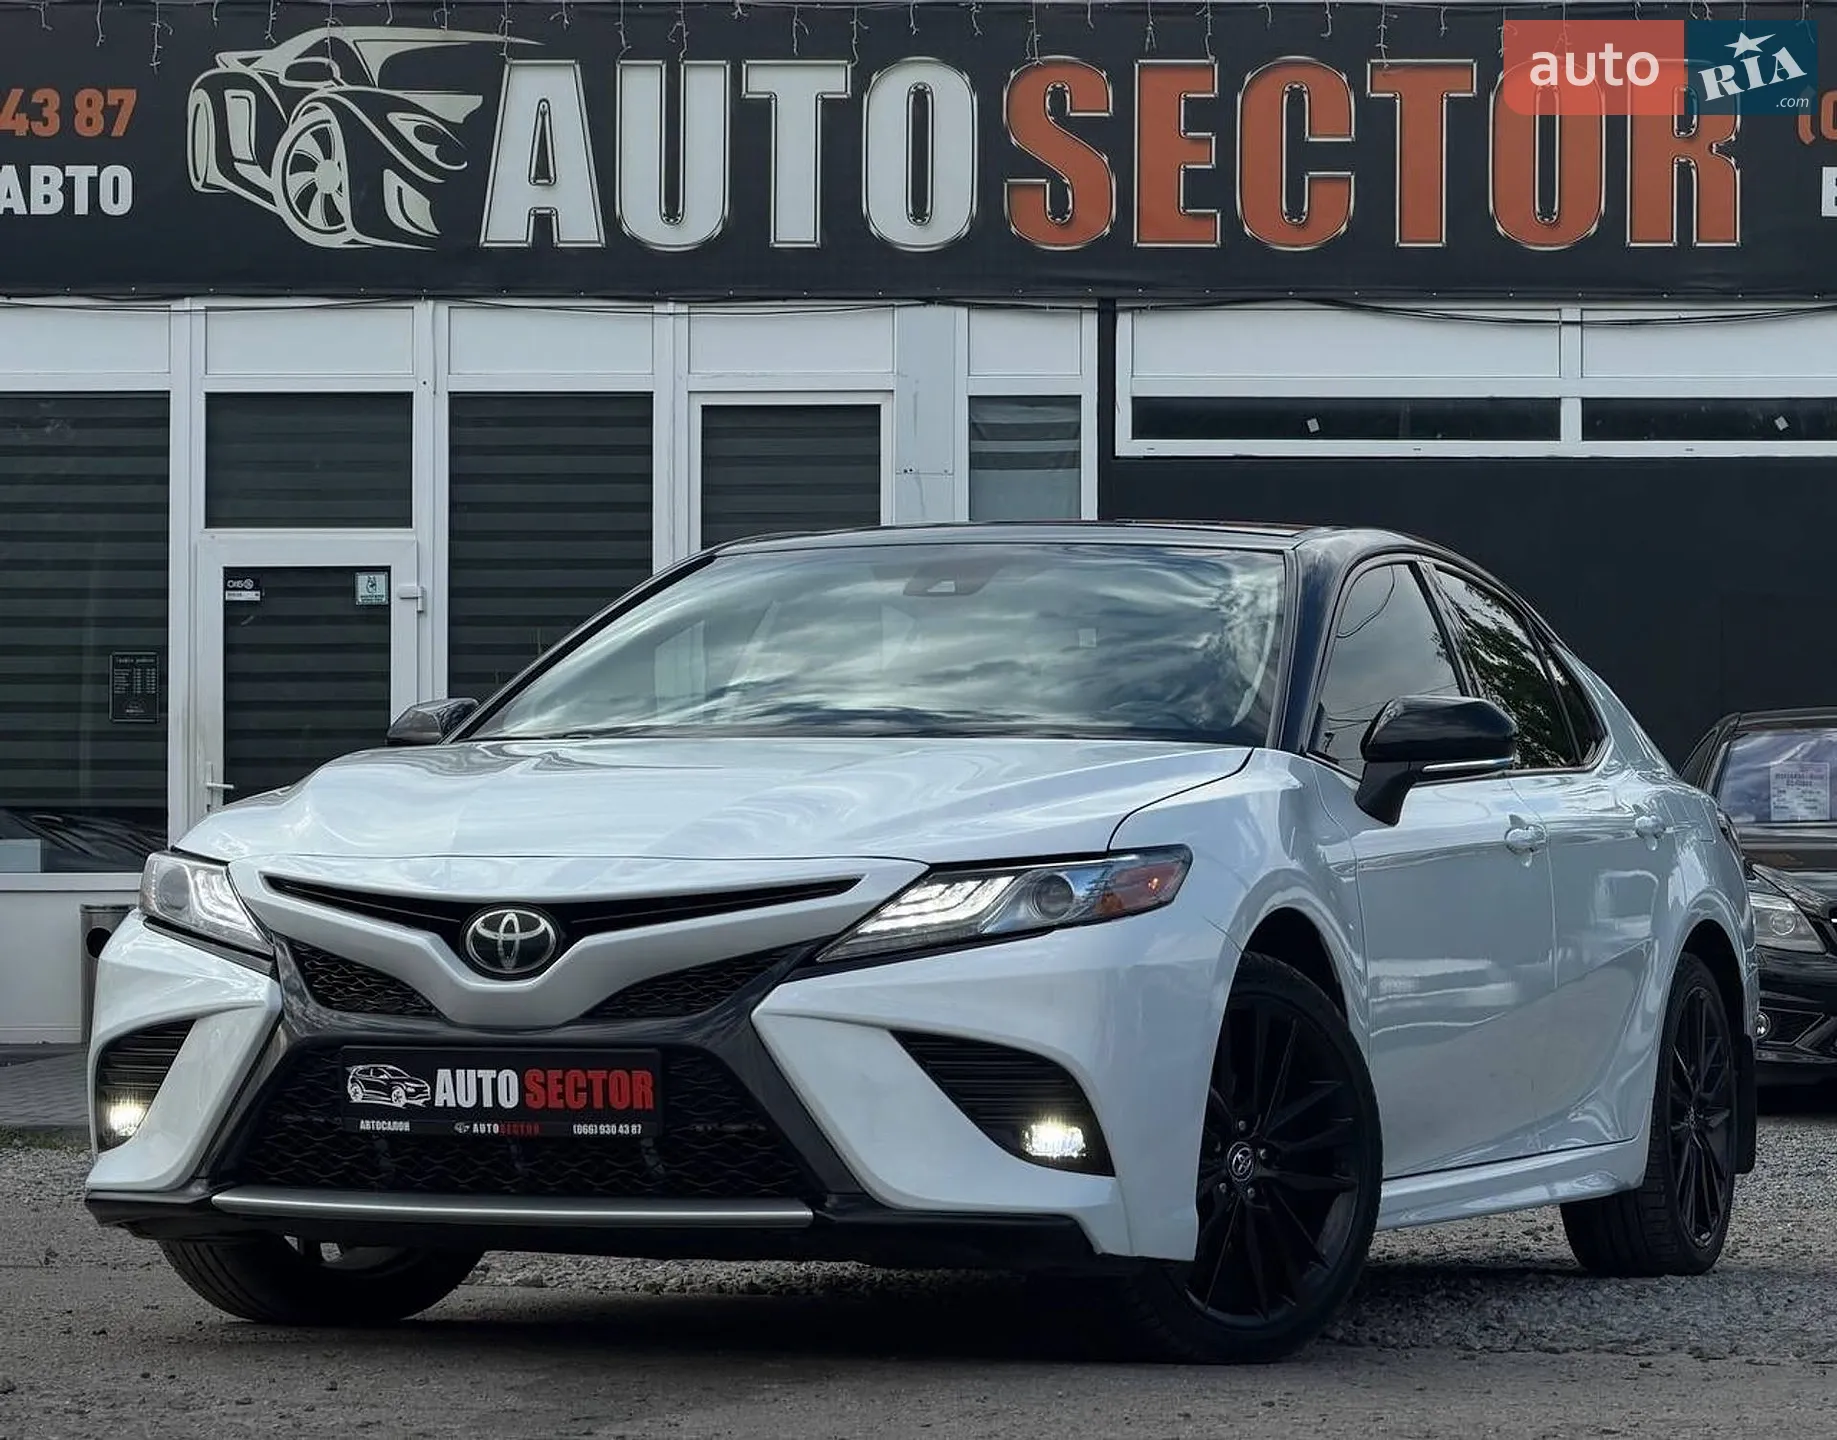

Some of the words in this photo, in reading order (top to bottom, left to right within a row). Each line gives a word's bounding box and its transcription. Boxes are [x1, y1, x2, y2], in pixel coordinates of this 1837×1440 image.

[0, 87, 60, 137] 43
[75, 87, 137, 137] 87
[0, 164, 133, 216] АВТО
[434, 1069, 519, 1109] AUTO
[525, 1068, 653, 1110] SECTOR
[599, 1123, 617, 1135] 930
[618, 1123, 630, 1135] 43
[631, 1123, 642, 1135] 87
